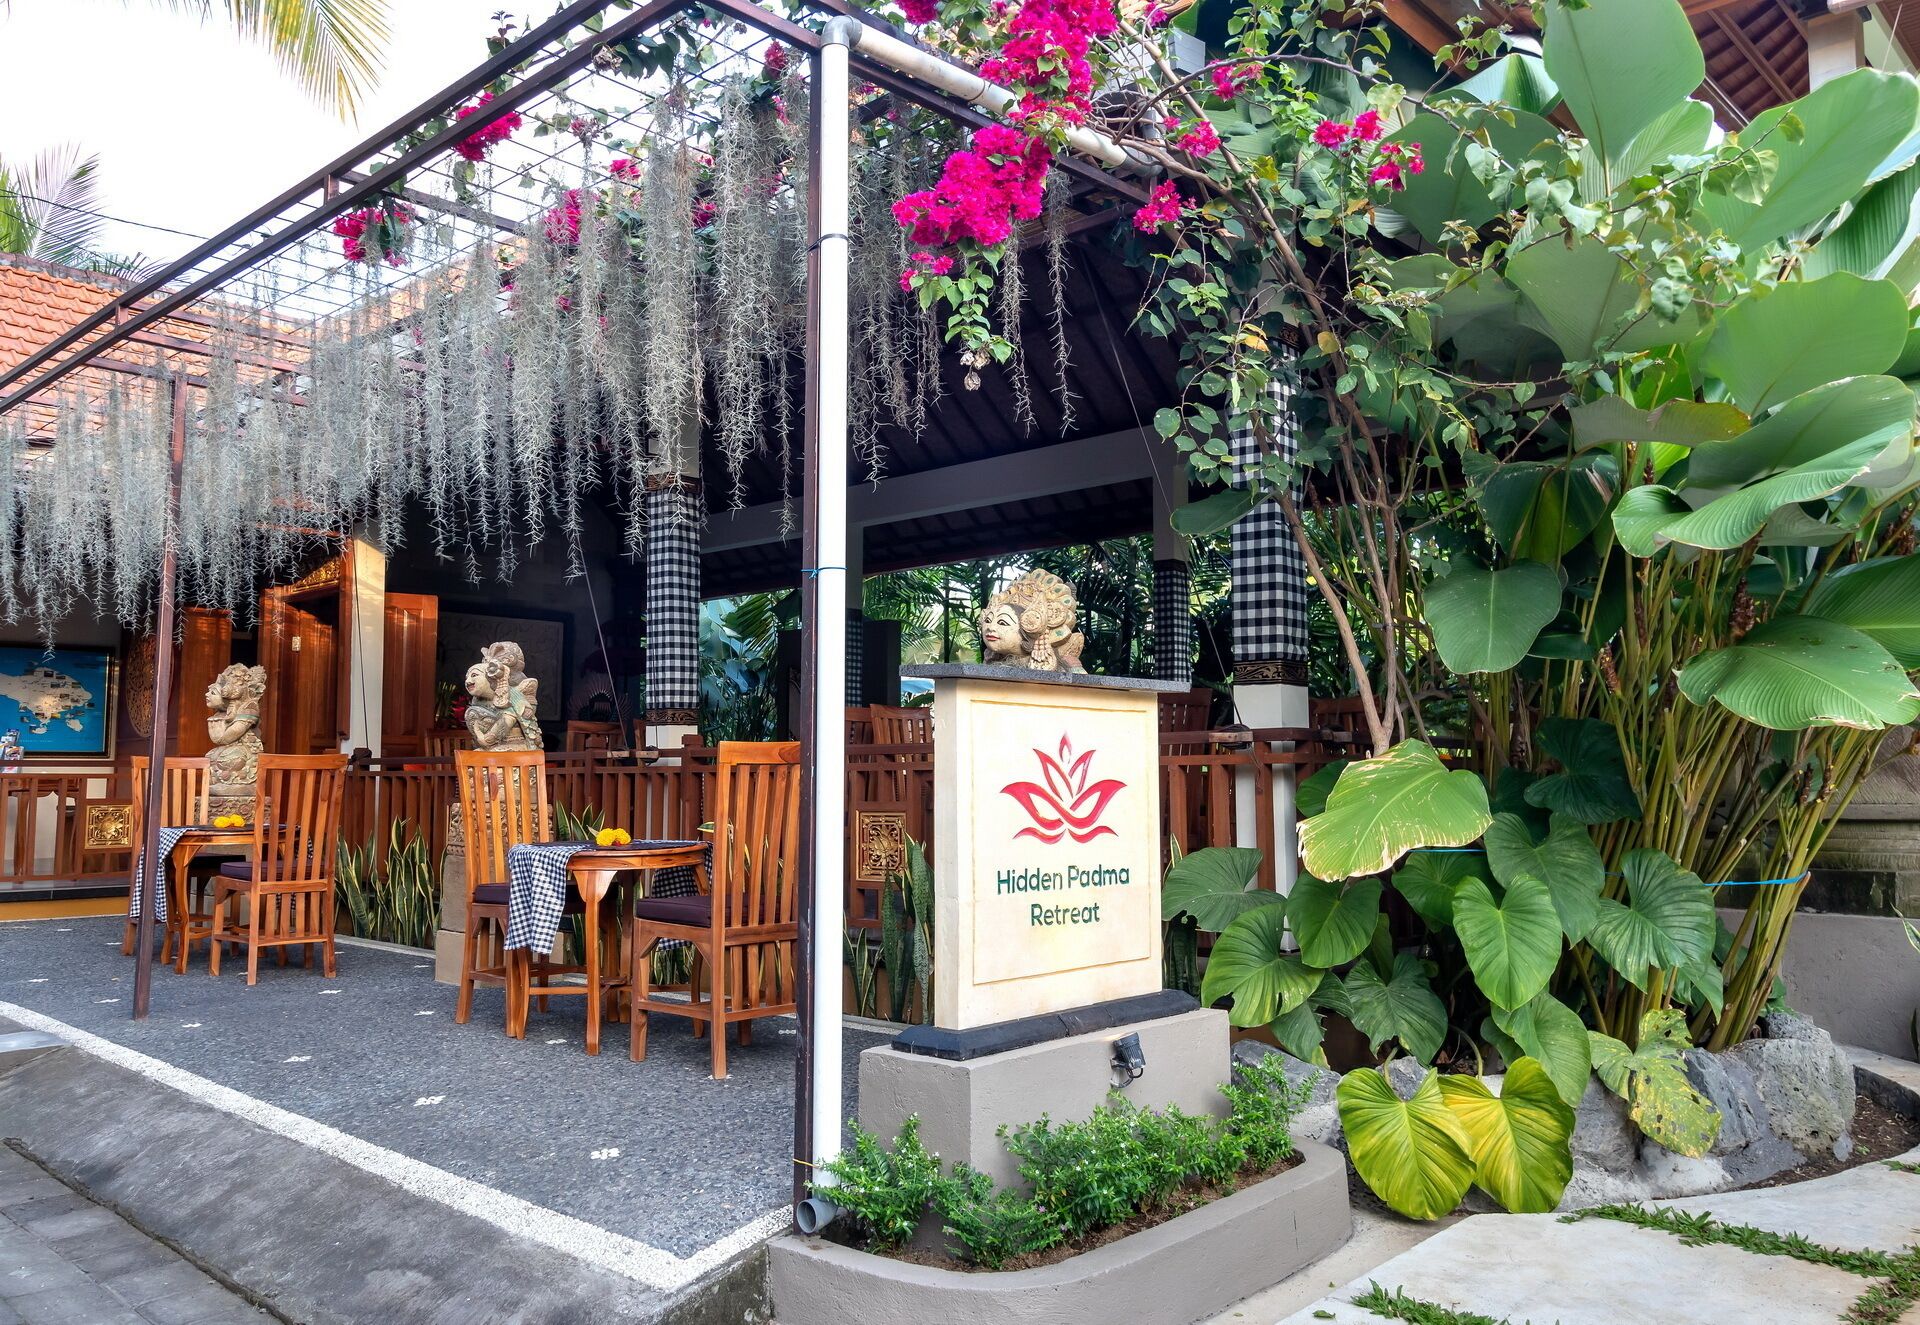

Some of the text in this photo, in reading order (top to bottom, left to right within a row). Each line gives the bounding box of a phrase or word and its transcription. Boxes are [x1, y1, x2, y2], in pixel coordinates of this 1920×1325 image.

[997, 864, 1130, 895] Hidden Padma
[1030, 902, 1100, 926] Retreat
